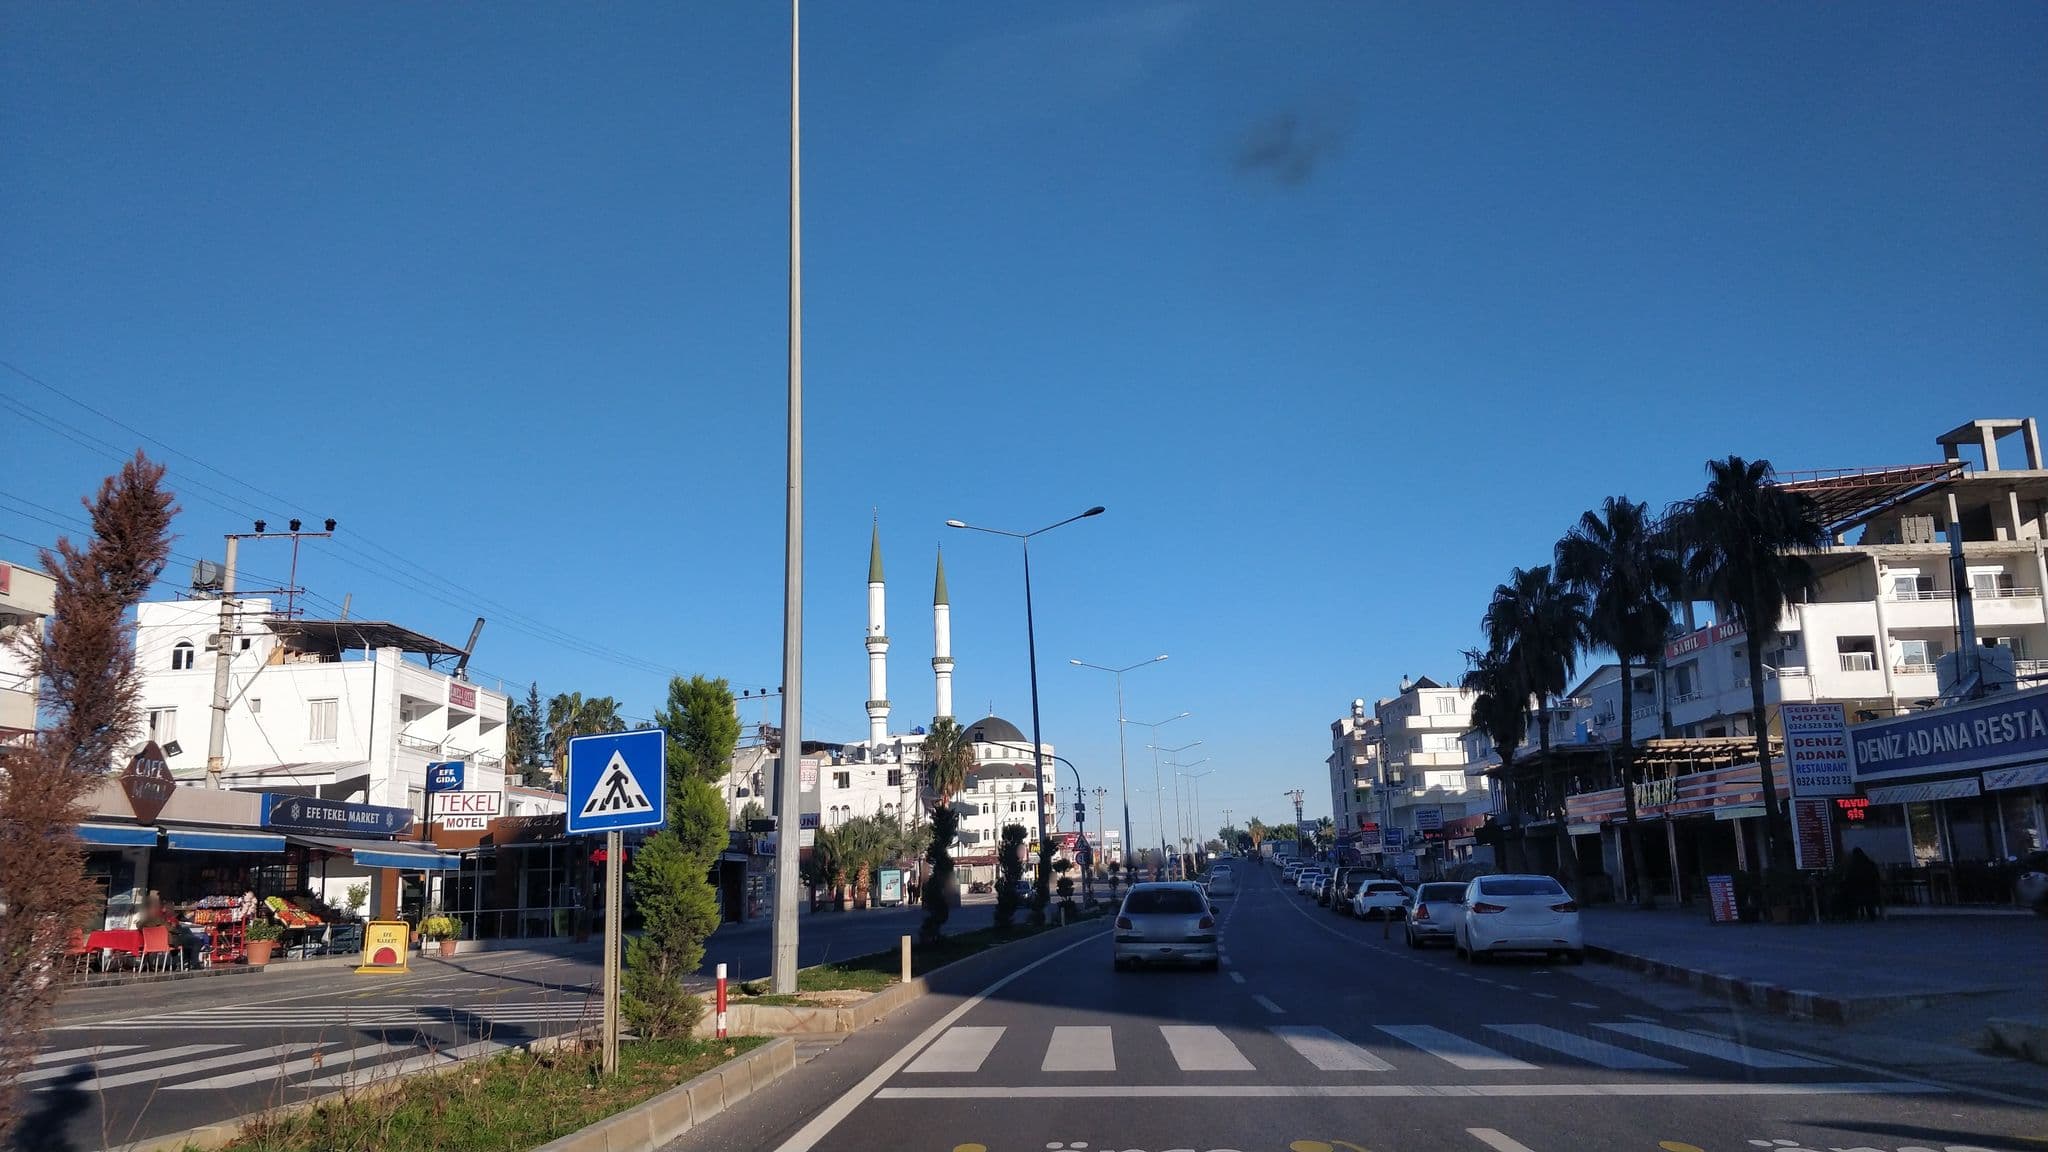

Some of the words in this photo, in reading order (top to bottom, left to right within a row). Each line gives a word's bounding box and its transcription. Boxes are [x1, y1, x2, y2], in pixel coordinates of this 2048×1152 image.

[1786, 705, 1840, 713] SEBASTE
[1791, 714, 1839, 722] MOTEL
[1857, 730, 1905, 765] DENİZ
[1907, 722, 1973, 758] ADANA
[1795, 750, 1846, 761] ADANA
[135, 757, 165, 778] CAFE
[438, 768, 455, 776] EFE
[1796, 762, 1848, 774] RESTAURANT
[435, 776, 457, 784] GIDA
[1796, 776, 1816, 786] 0324
[1816, 776, 1831, 785] 523
[1831, 775, 1842, 785] 22
[1842, 775, 1852, 784] 33
[439, 794, 496, 812] TEKEL
[306, 806, 321, 819] EFE
[322, 808, 347, 822] TEKEL
[347, 811, 380, 824] MARKET
[446, 817, 485, 829] MOTEL
